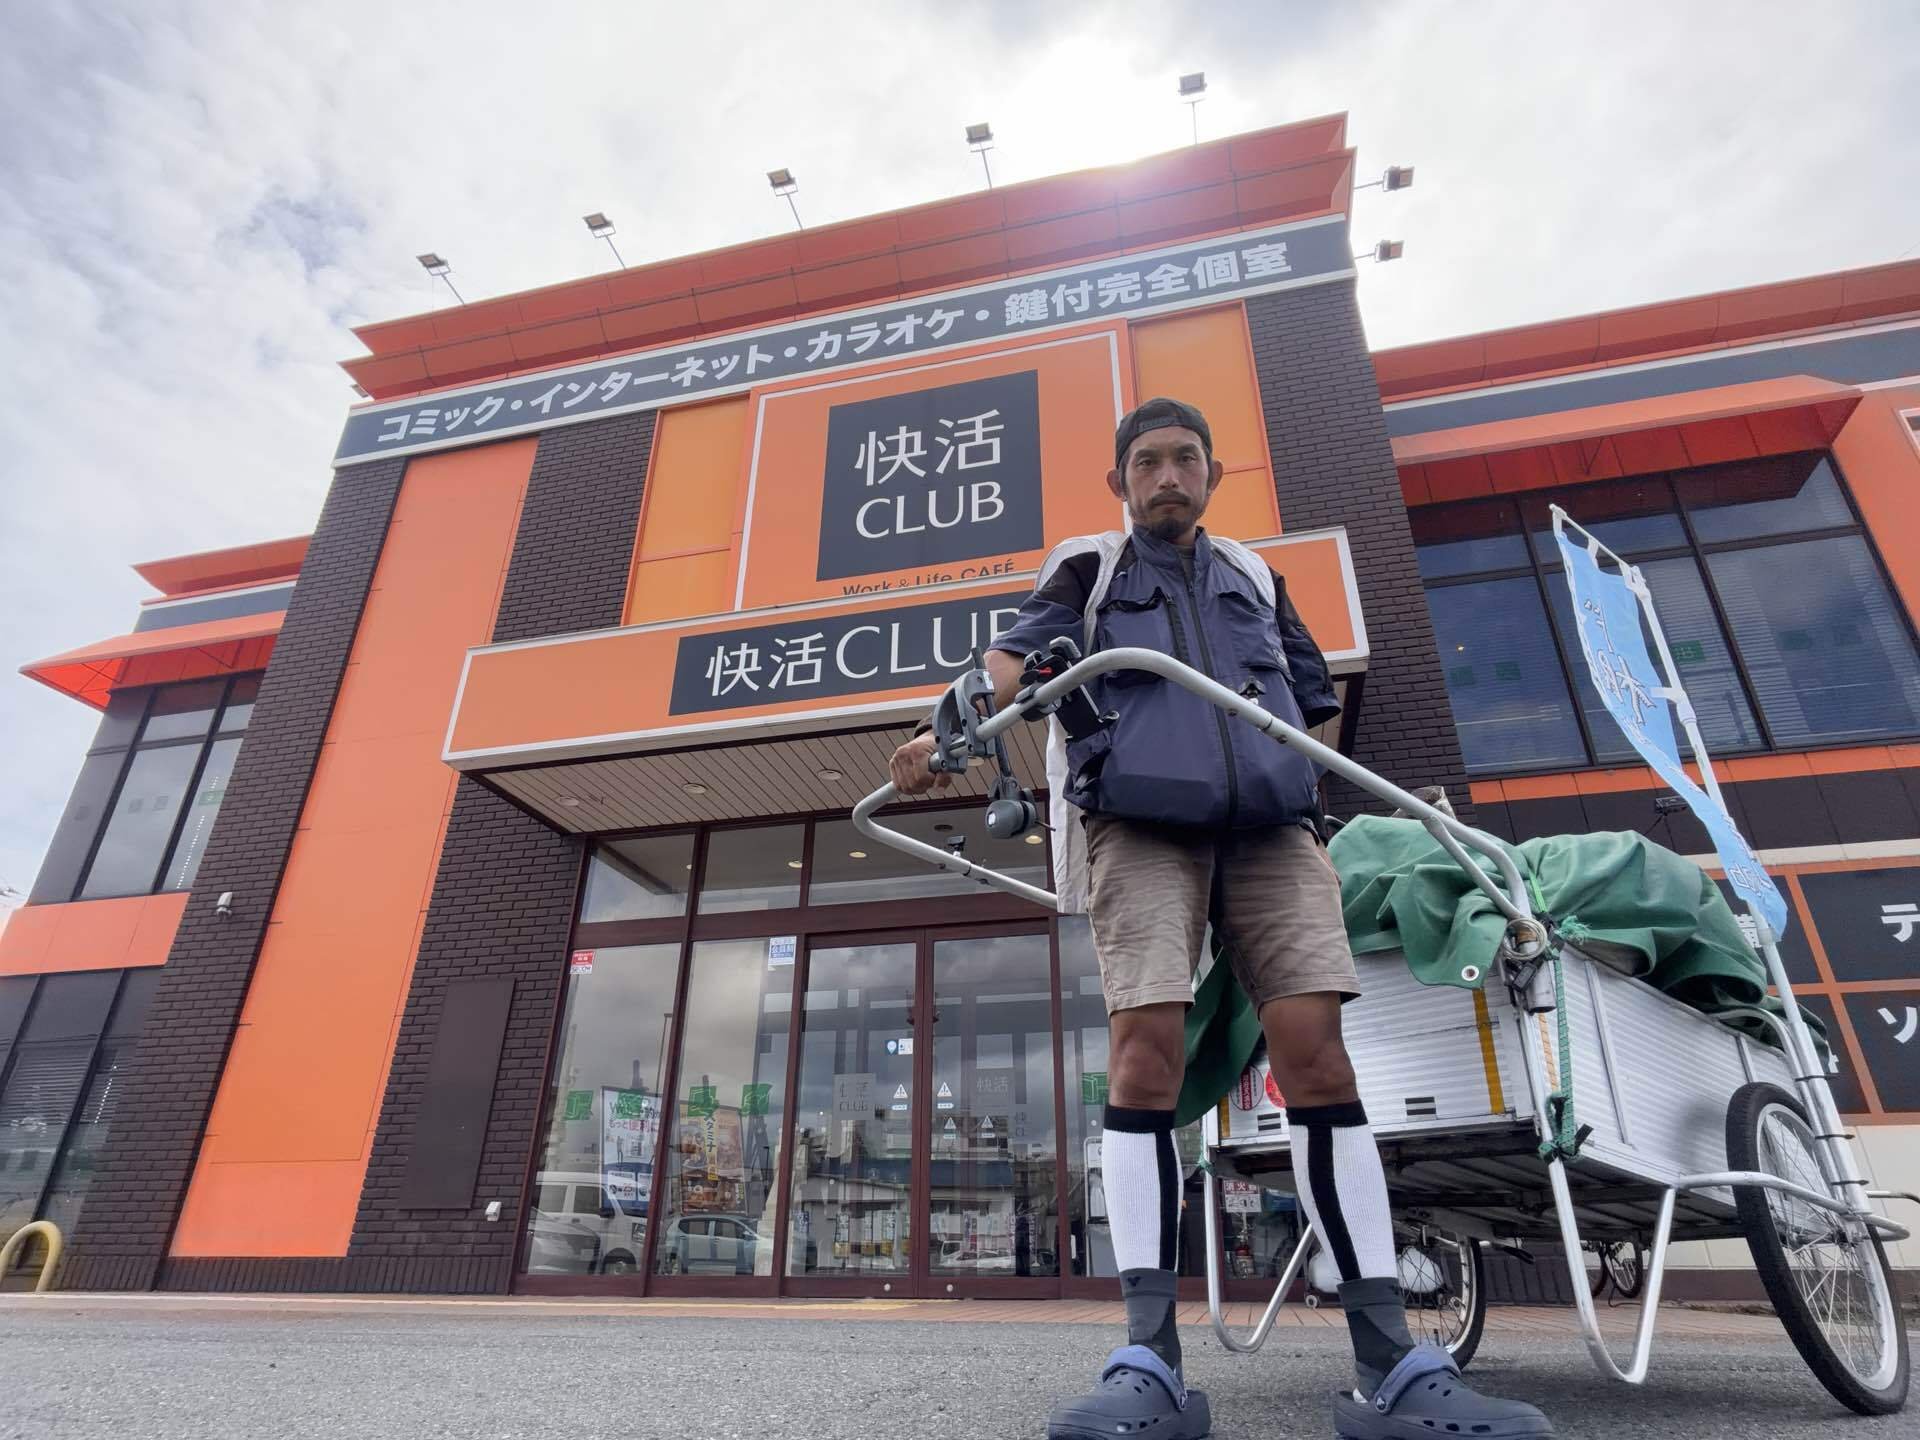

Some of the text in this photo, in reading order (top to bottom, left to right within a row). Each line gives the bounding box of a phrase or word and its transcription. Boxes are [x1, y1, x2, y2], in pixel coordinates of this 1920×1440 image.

[377, 241, 1291, 443] コミック・インターネット・カラオケ・鍵付完全個室
[854, 408, 1005, 487] 快活
[855, 481, 1005, 539] CLUB
